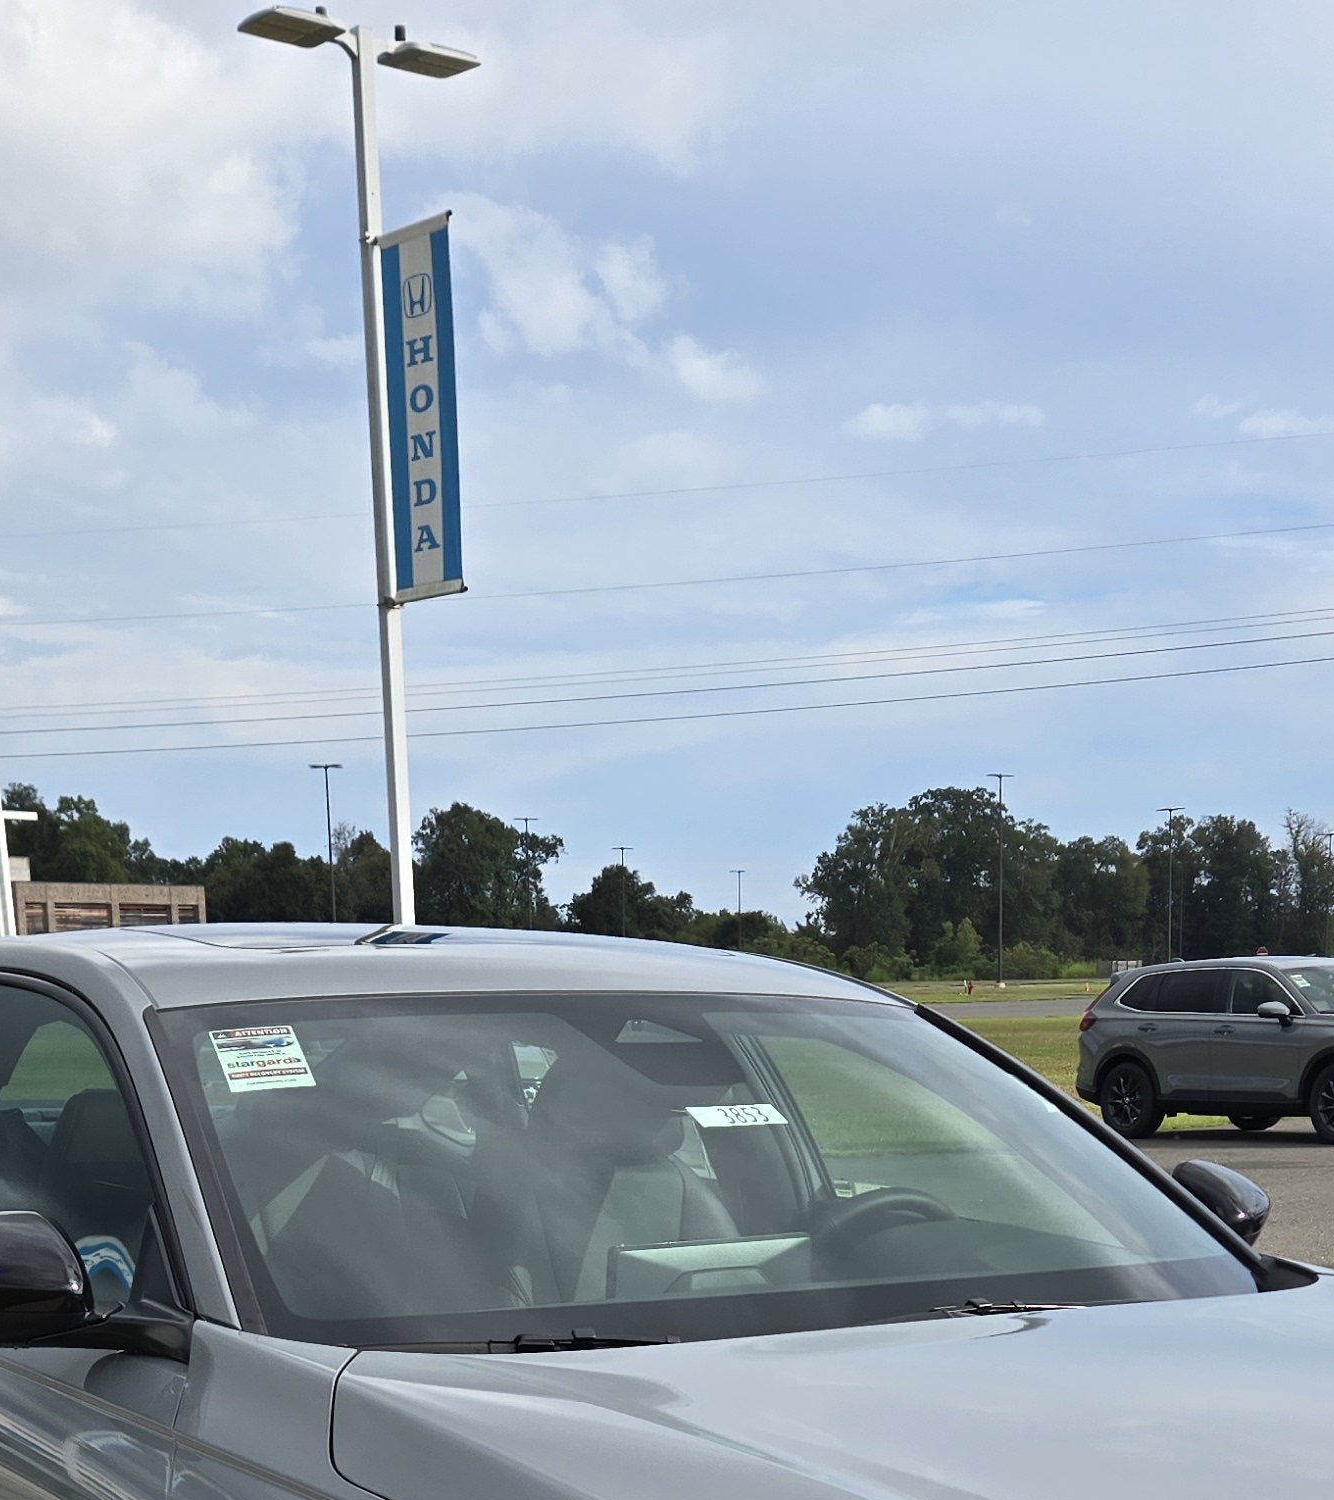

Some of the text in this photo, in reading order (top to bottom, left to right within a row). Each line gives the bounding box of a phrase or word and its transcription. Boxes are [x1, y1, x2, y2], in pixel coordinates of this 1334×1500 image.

[406, 334, 440, 553] HONDA
[234, 1028, 288, 1038] ATTENTION
[716, 1106, 769, 1124] 3853
